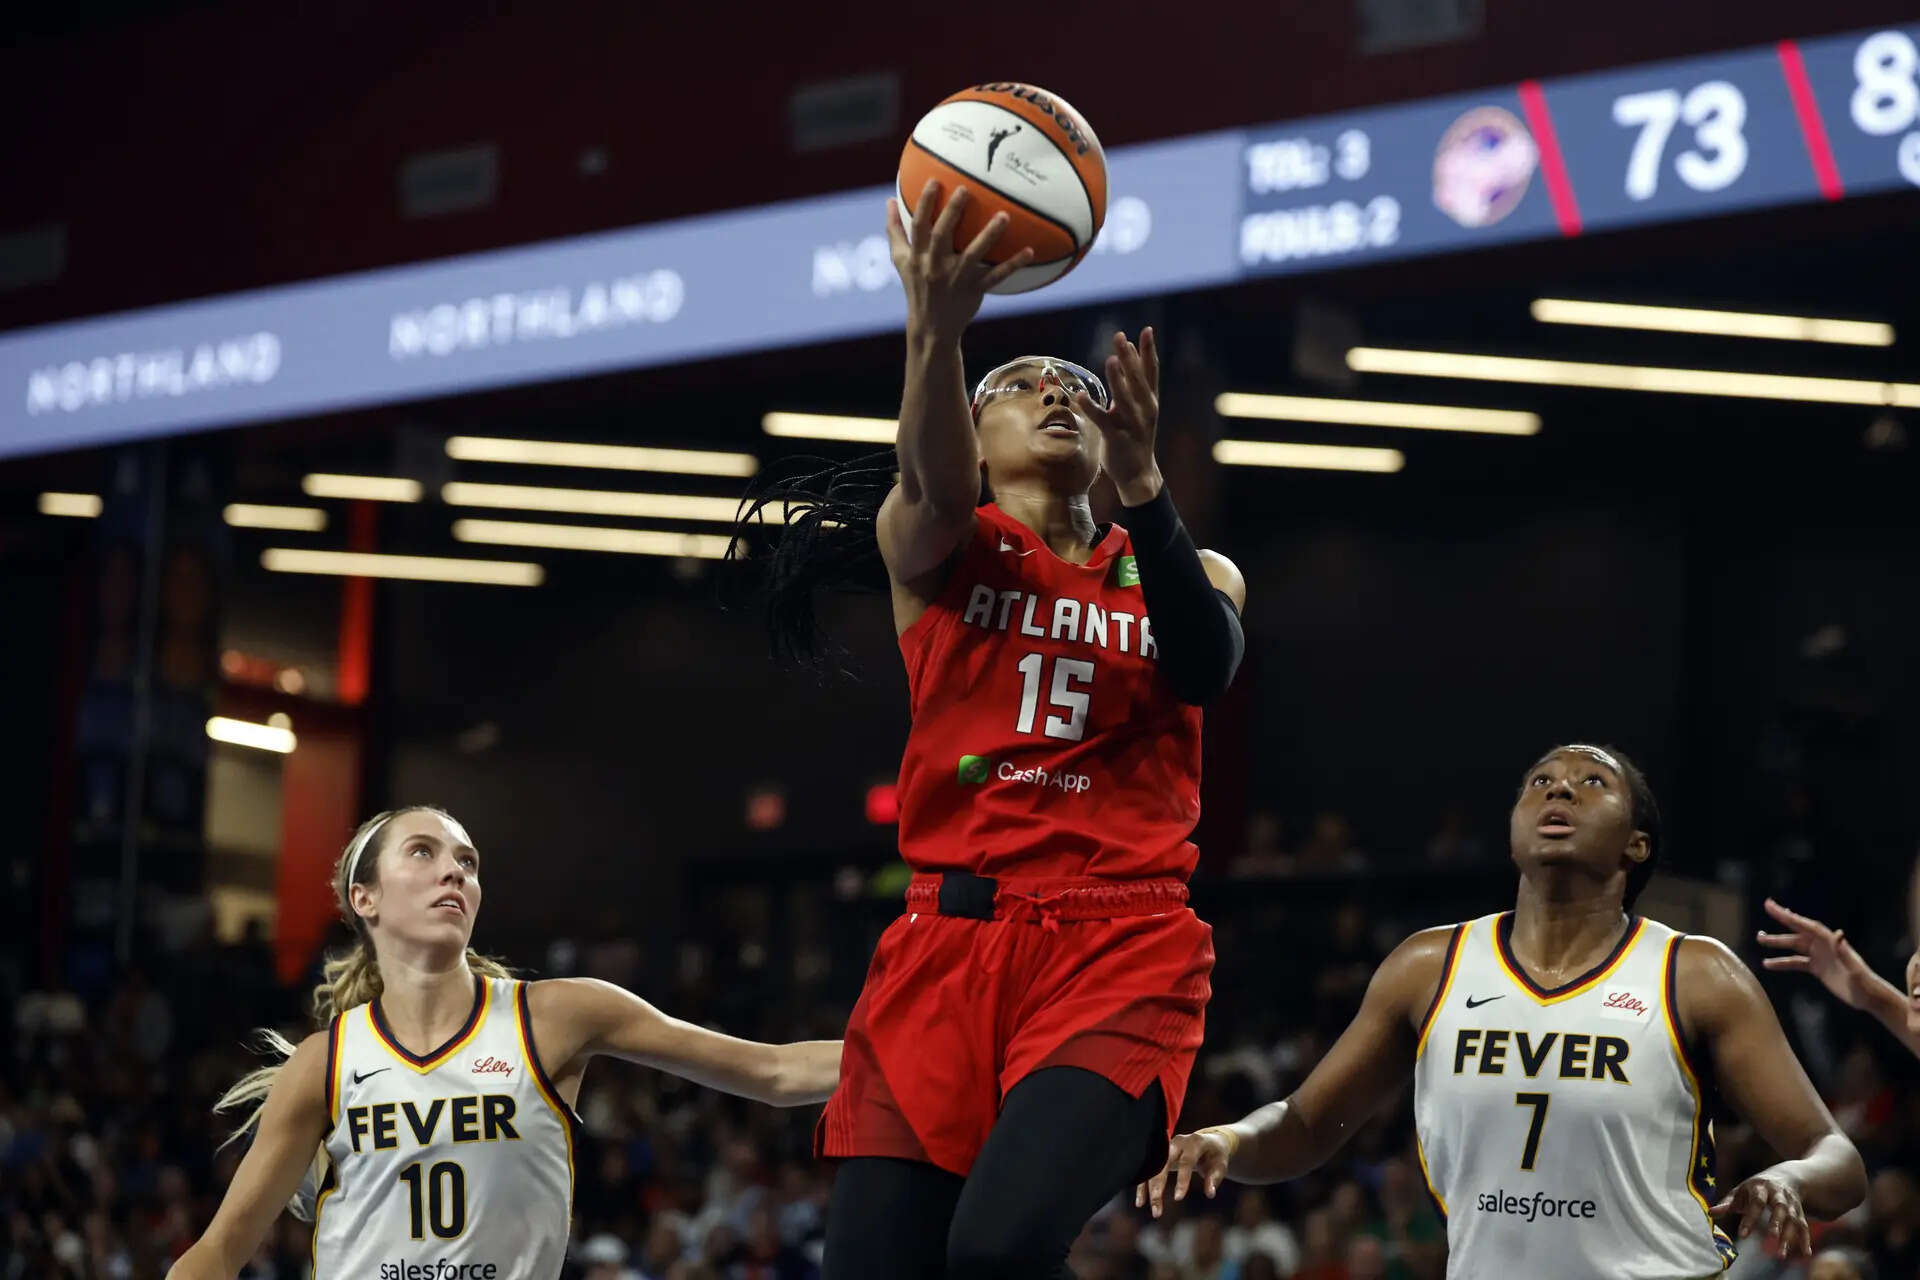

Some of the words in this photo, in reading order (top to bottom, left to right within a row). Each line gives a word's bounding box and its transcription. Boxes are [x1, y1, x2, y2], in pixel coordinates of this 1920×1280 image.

[1851, 31, 1920, 136] 8
[1335, 129, 1371, 180] 3
[1612, 80, 1748, 201] 73
[388, 269, 684, 359] NORTHLAND
[27, 331, 281, 415] NORTHLAND
[963, 583, 1159, 660] ATLANTA
[1014, 652, 1095, 742] 15
[998, 761, 1048, 786] Cash
[1050, 770, 1091, 793] App
[1603, 992, 1649, 1017] Lilly
[471, 1056, 515, 1077] Lilly
[1453, 1029, 1632, 1086] FEVER
[346, 1094, 521, 1153] FEVER
[1515, 1092, 1551, 1173] 7
[399, 1161, 466, 1241] 10
[1477, 1189, 1597, 1223] salesforce
[380, 1258, 497, 1280] salesforce
